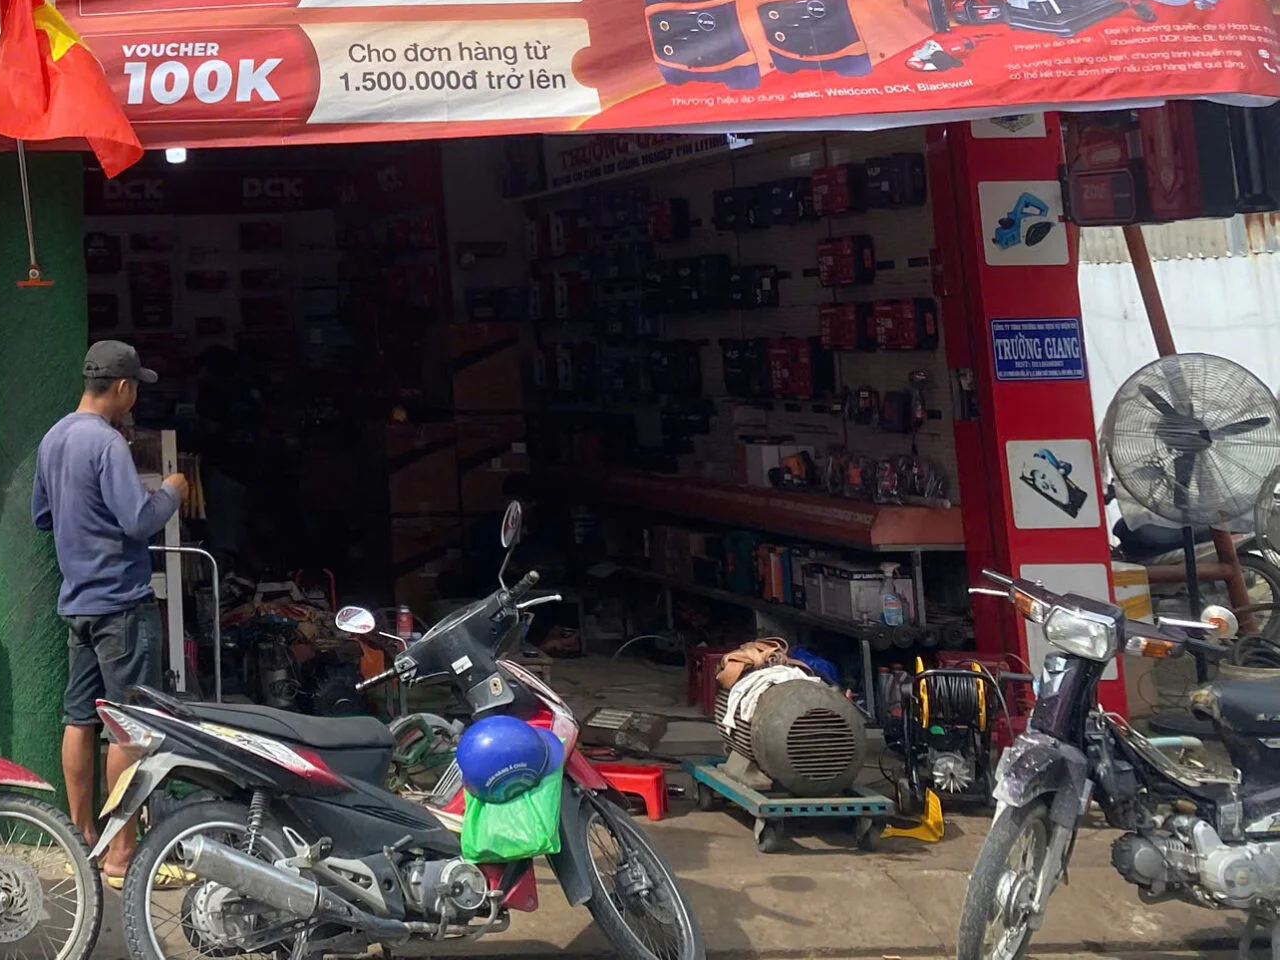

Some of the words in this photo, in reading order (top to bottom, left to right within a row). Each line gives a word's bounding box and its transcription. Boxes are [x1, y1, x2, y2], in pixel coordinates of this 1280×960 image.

[122, 41, 220, 59] VOUCHER
[348, 42, 400, 65] Cho
[404, 40, 453, 63] đơn
[456, 38, 518, 66] hàng
[522, 38, 552, 61] từ
[122, 57, 284, 106] 100K
[339, 69, 479, 93] 1.500.000đ
[486, 66, 525, 91] trở
[528, 68, 567, 90] lên
[995, 332, 1042, 360] TRƯỜNG
[1044, 336, 1080, 359] GIANG
